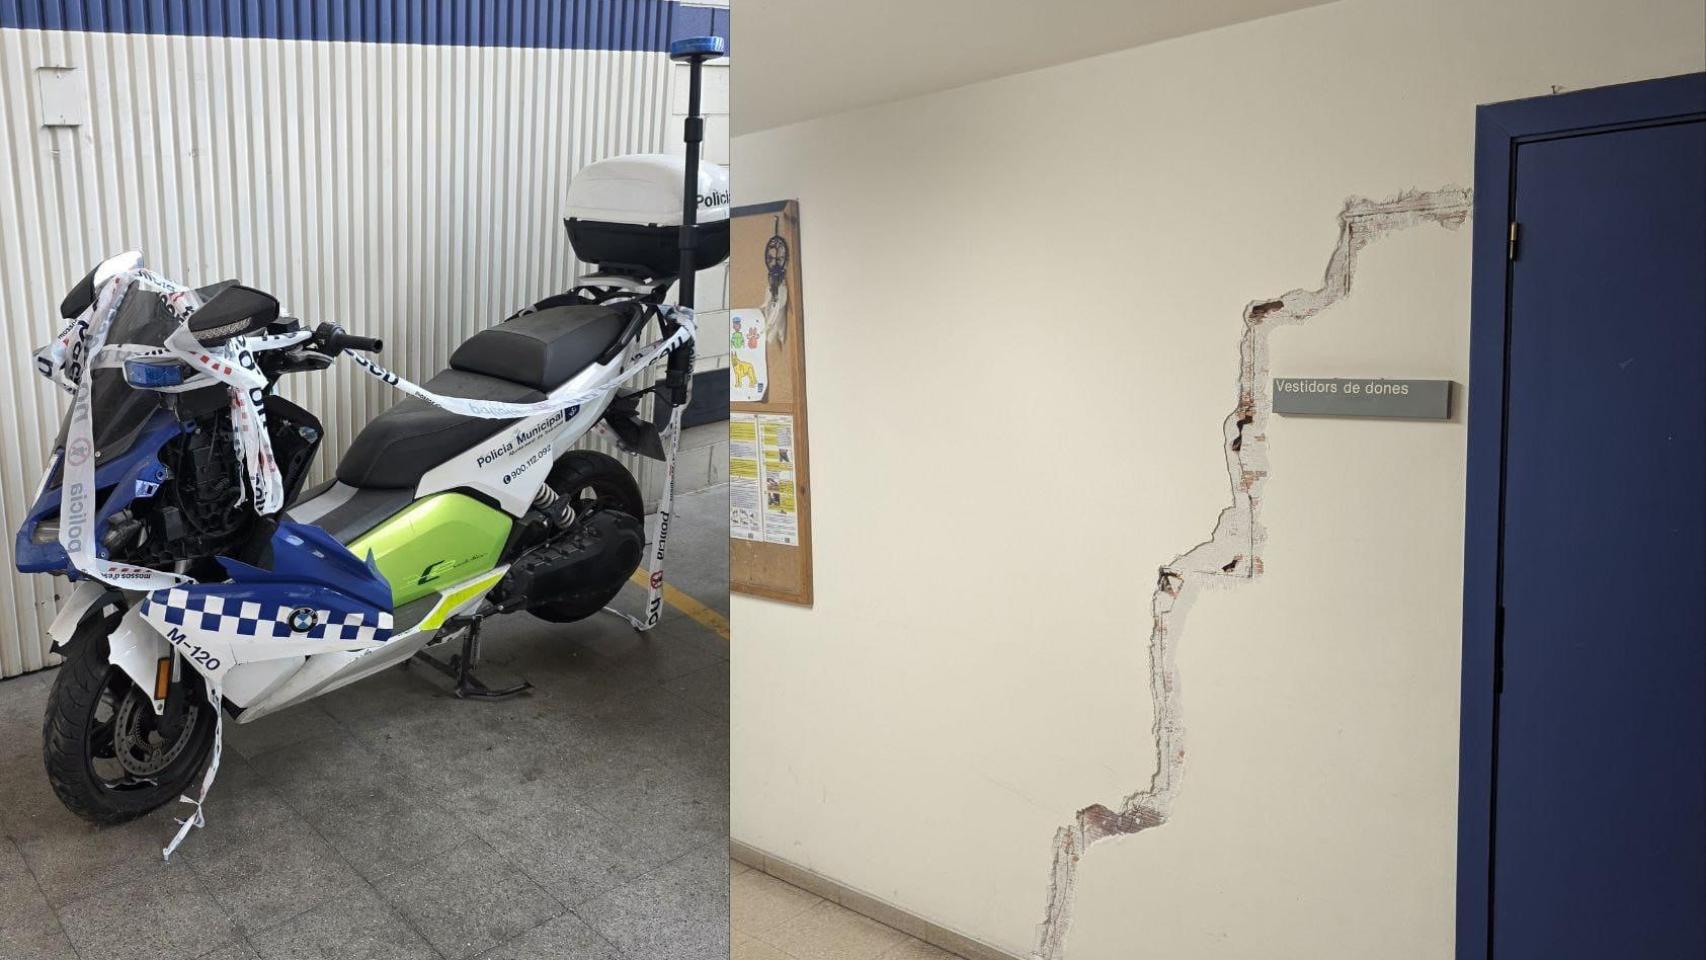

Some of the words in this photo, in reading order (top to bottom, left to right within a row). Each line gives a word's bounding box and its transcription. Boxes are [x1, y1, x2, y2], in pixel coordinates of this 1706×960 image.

[696, 190, 730, 208] Polici
[1276, 380, 1338, 393] Vestidors
[1343, 381, 1361, 394] de
[1365, 381, 1409, 395] dones
[476, 442, 513, 468] Policia
[516, 409, 564, 444] Municipal
[511, 444, 552, 479] 900.112.092
[167, 627, 221, 671] M-120
